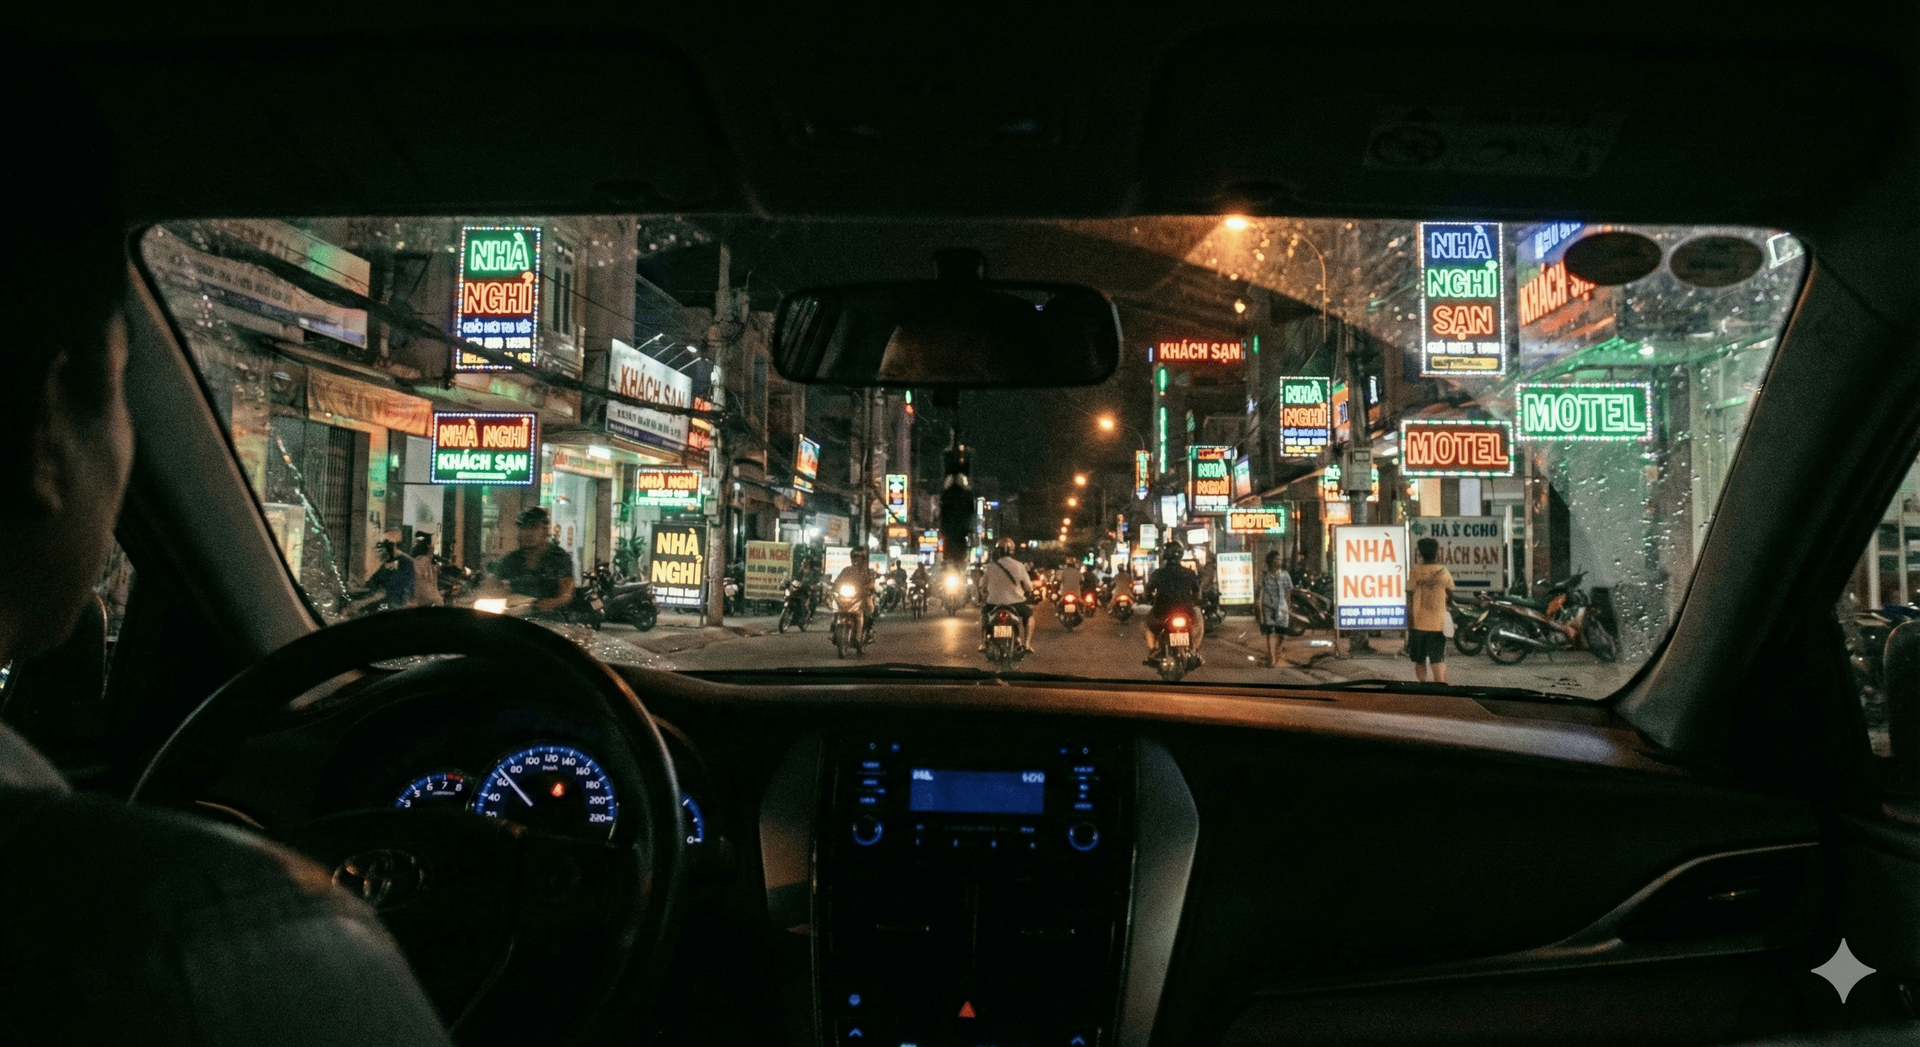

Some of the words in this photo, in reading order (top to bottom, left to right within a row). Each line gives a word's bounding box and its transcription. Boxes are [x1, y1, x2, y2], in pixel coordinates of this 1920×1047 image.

[471, 232, 529, 270] NHÀ
[1432, 225, 1492, 259] NHÀ
[1427, 260, 1498, 298] NGHỈ
[464, 272, 534, 314] NGHỈ
[1520, 260, 1568, 327] KHÁCH
[1433, 305, 1493, 341] SẠN
[1160, 339, 1208, 360] KHÁCH
[1211, 342, 1240, 363] SẠN
[619, 364, 661, 404] KHÁCH
[1285, 380, 1323, 404] NHÀ
[1283, 403, 1327, 427] NGHỈ
[1524, 394, 1646, 432] MOTEL
[439, 418, 478, 447] NHÀ
[483, 417, 530, 448] NGHỈ
[1407, 432, 1508, 465] MOTEL
[437, 449, 491, 470] KHÁCH
[495, 454, 527, 475] SẠN
[1232, 514, 1279, 529] MOTEL
[657, 528, 700, 555] NHÀ
[1345, 532, 1397, 562] NHÀ
[652, 555, 703, 585] NGHỈ
[1474, 546, 1498, 571] SẠN
[1343, 565, 1403, 599] NGHỈ
[510, 765, 523, 774] 80
[526, 757, 540, 766] 100
[562, 757, 576, 766] 140
[576, 766, 591, 776] 160
[414, 789, 421, 798] 5
[426, 783, 434, 791] 6
[442, 781, 449, 790] 7
[488, 793, 501, 802] 40
[589, 796, 606, 805] 200
[589, 813, 606, 823] 220
